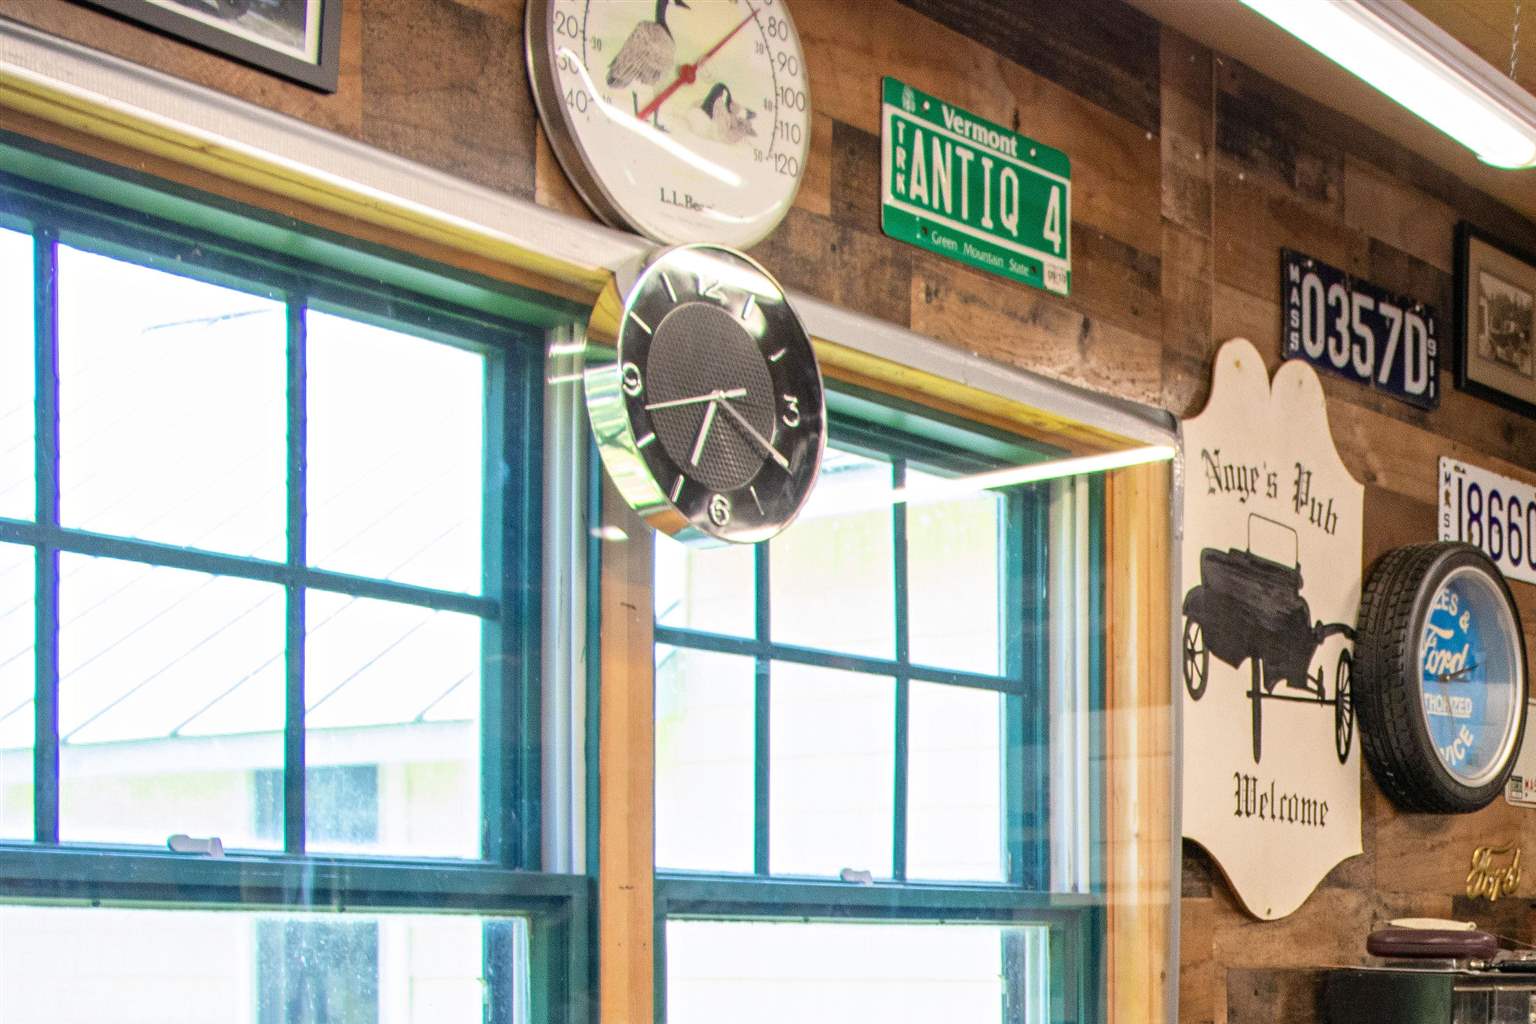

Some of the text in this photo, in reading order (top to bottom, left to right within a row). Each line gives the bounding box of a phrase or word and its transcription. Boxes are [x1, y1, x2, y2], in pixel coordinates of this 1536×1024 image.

[767, 17, 788, 41] 80
[777, 51, 798, 76] 90
[567, 91, 587, 113] 40
[942, 104, 1018, 158] Vermont
[774, 152, 798, 178] 120
[910, 129, 1061, 254] ANTIQ 4
[932, 231, 1030, 276] Green Mountain State
[707, 493, 731, 527] 6
[1292, 462, 1338, 536] Pub
[1233, 771, 1329, 828] Welcome
